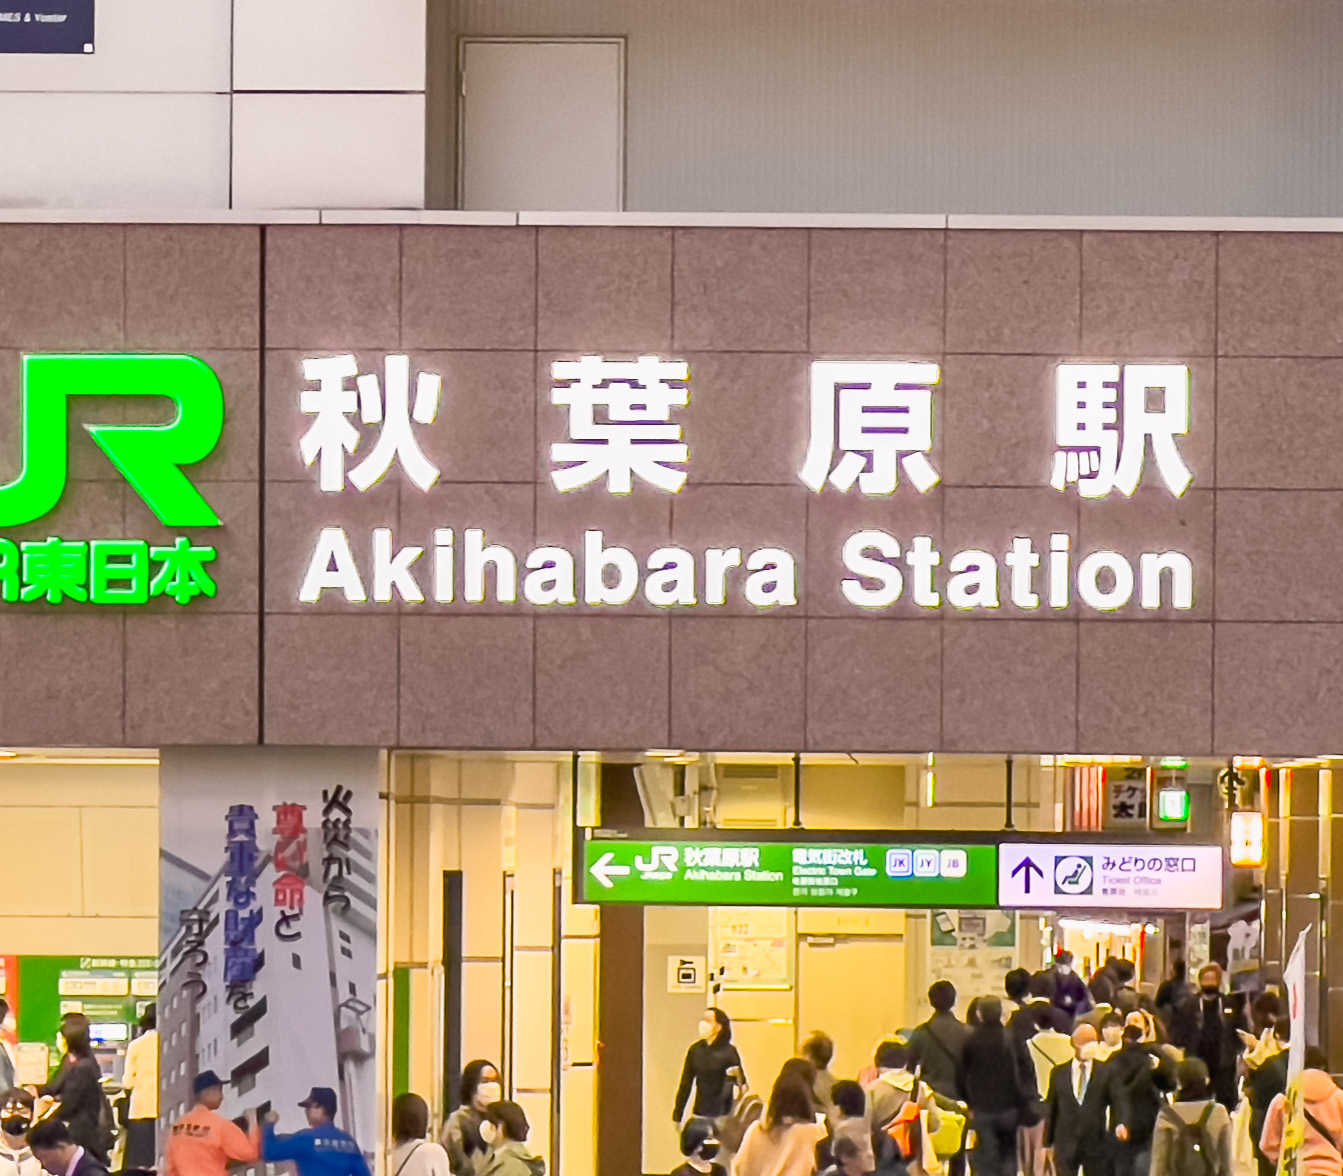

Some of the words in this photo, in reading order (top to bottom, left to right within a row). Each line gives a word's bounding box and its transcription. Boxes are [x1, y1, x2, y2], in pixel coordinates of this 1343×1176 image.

[299, 353, 1193, 497] 秋葉原駅
[298, 526, 798, 608] Akihabara
[840, 528, 1194, 611] Station
[321, 784, 354, 912] 火災から
[635, 846, 679, 872] JR
[893, 857, 907, 868] JK
[1101, 856, 1196, 873] みどりの窓口
